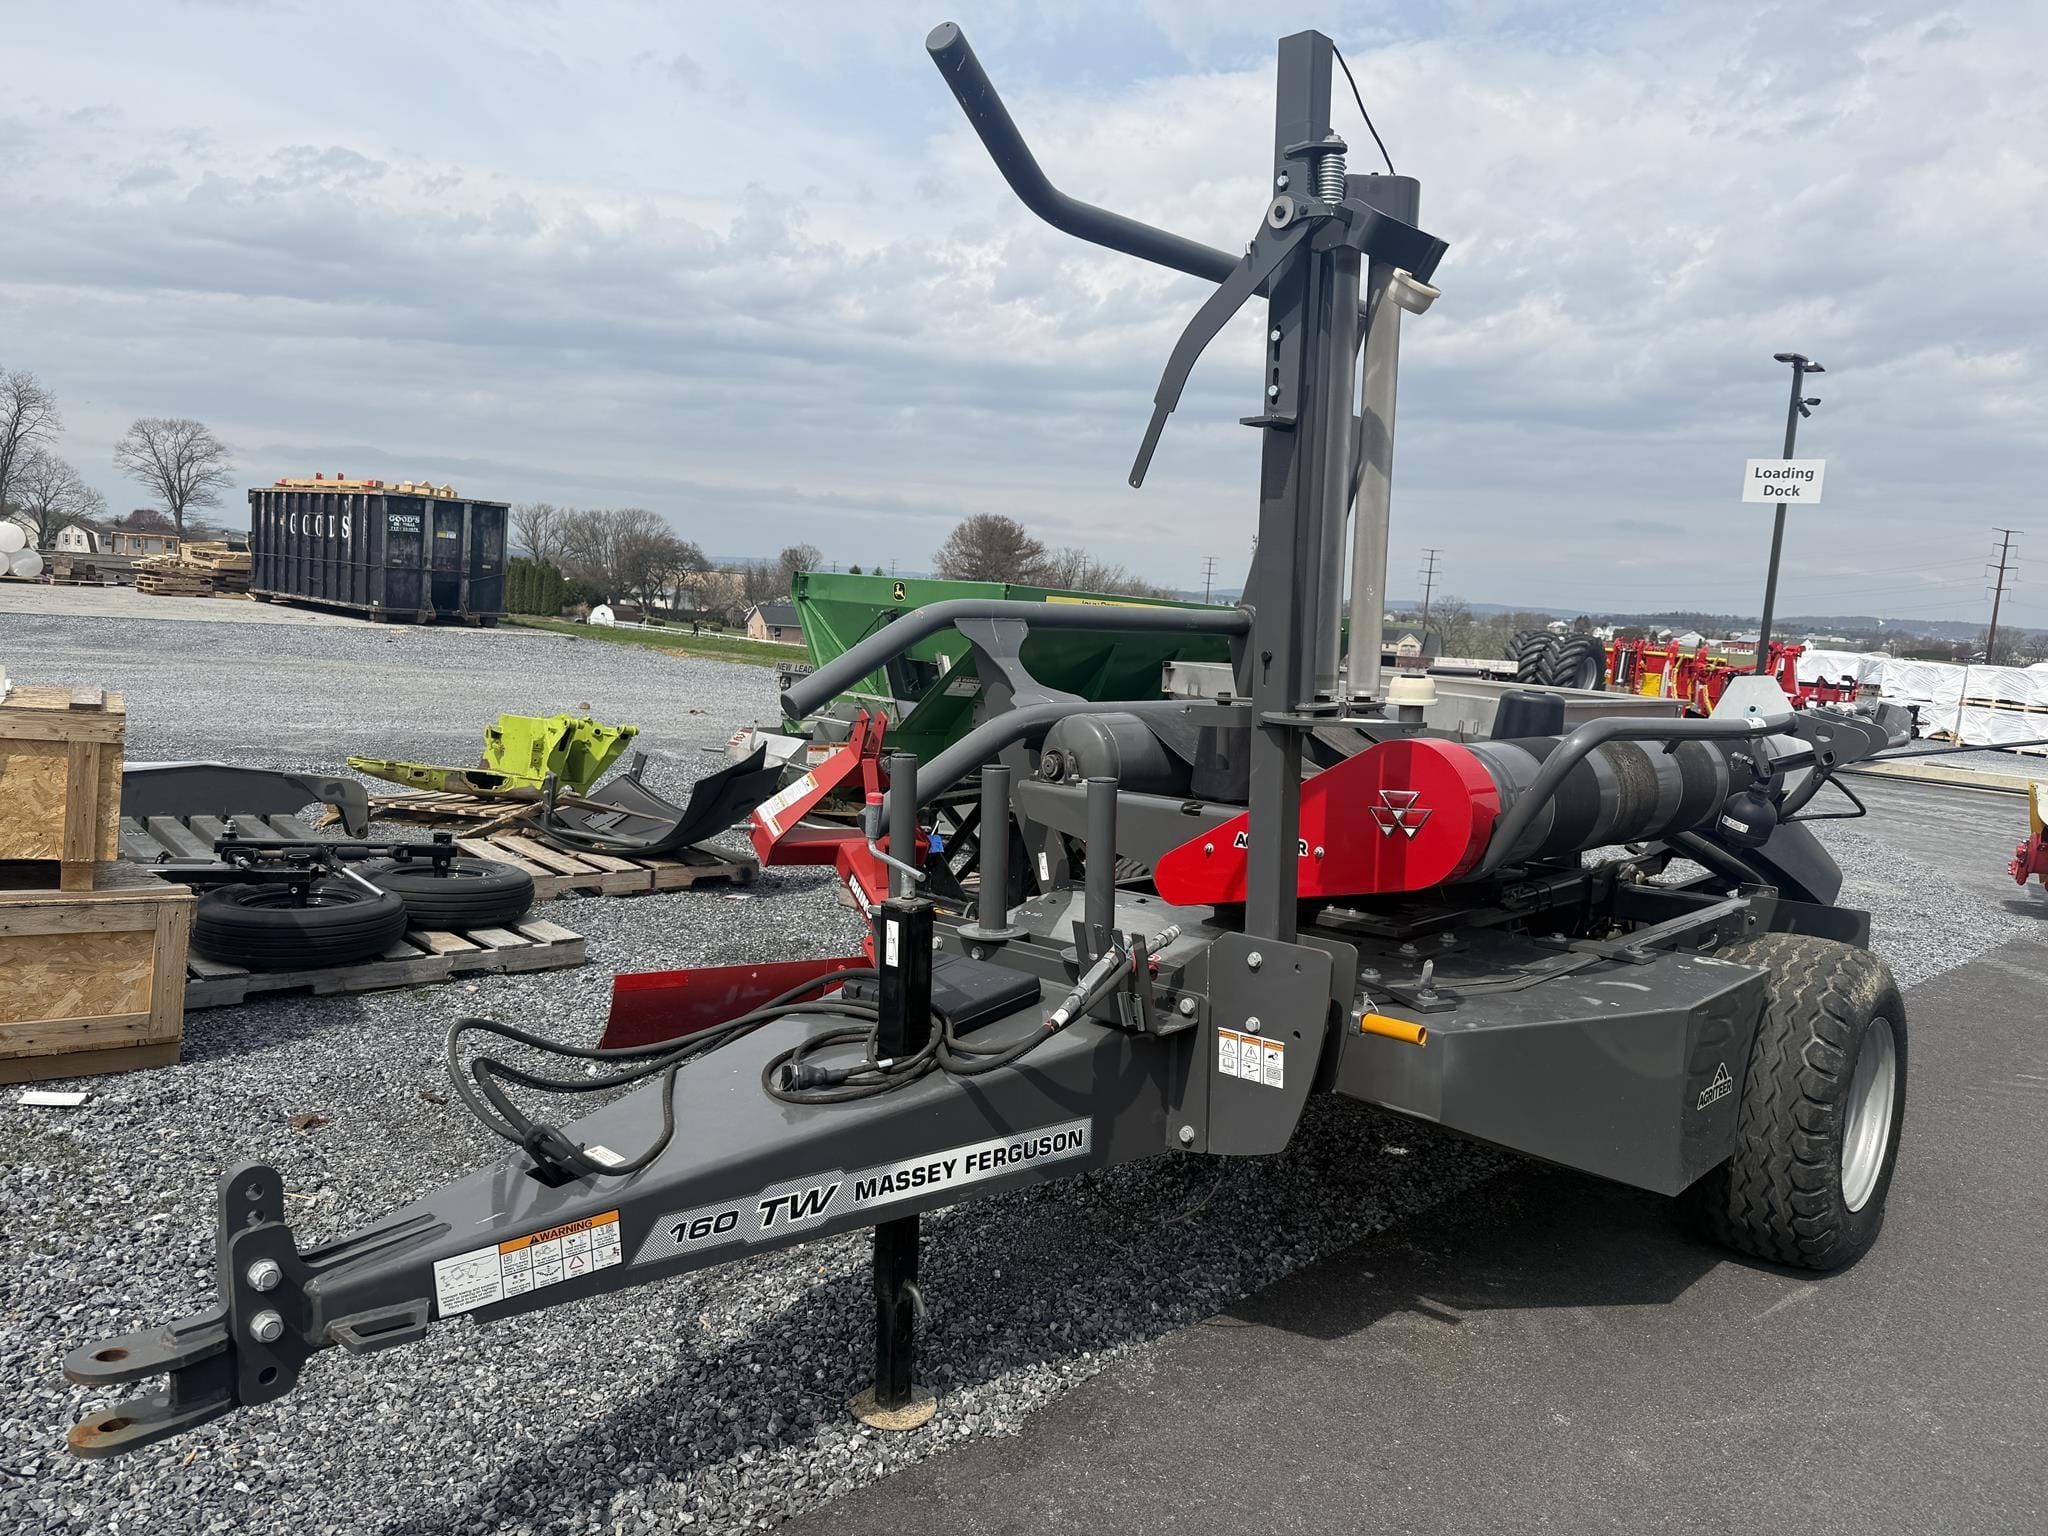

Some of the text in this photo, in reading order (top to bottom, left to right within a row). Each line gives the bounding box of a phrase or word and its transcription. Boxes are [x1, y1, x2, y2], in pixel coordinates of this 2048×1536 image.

[1755, 467, 1814, 482] Loading
[1763, 484, 1800, 496] Dock
[776, 662, 793, 672] NEW
[1697, 1077, 1733, 1109] AGRITEER
[669, 1128, 1084, 1244] 160 TW MASSEY FERGUSON
[540, 1219, 593, 1242] WARNING
